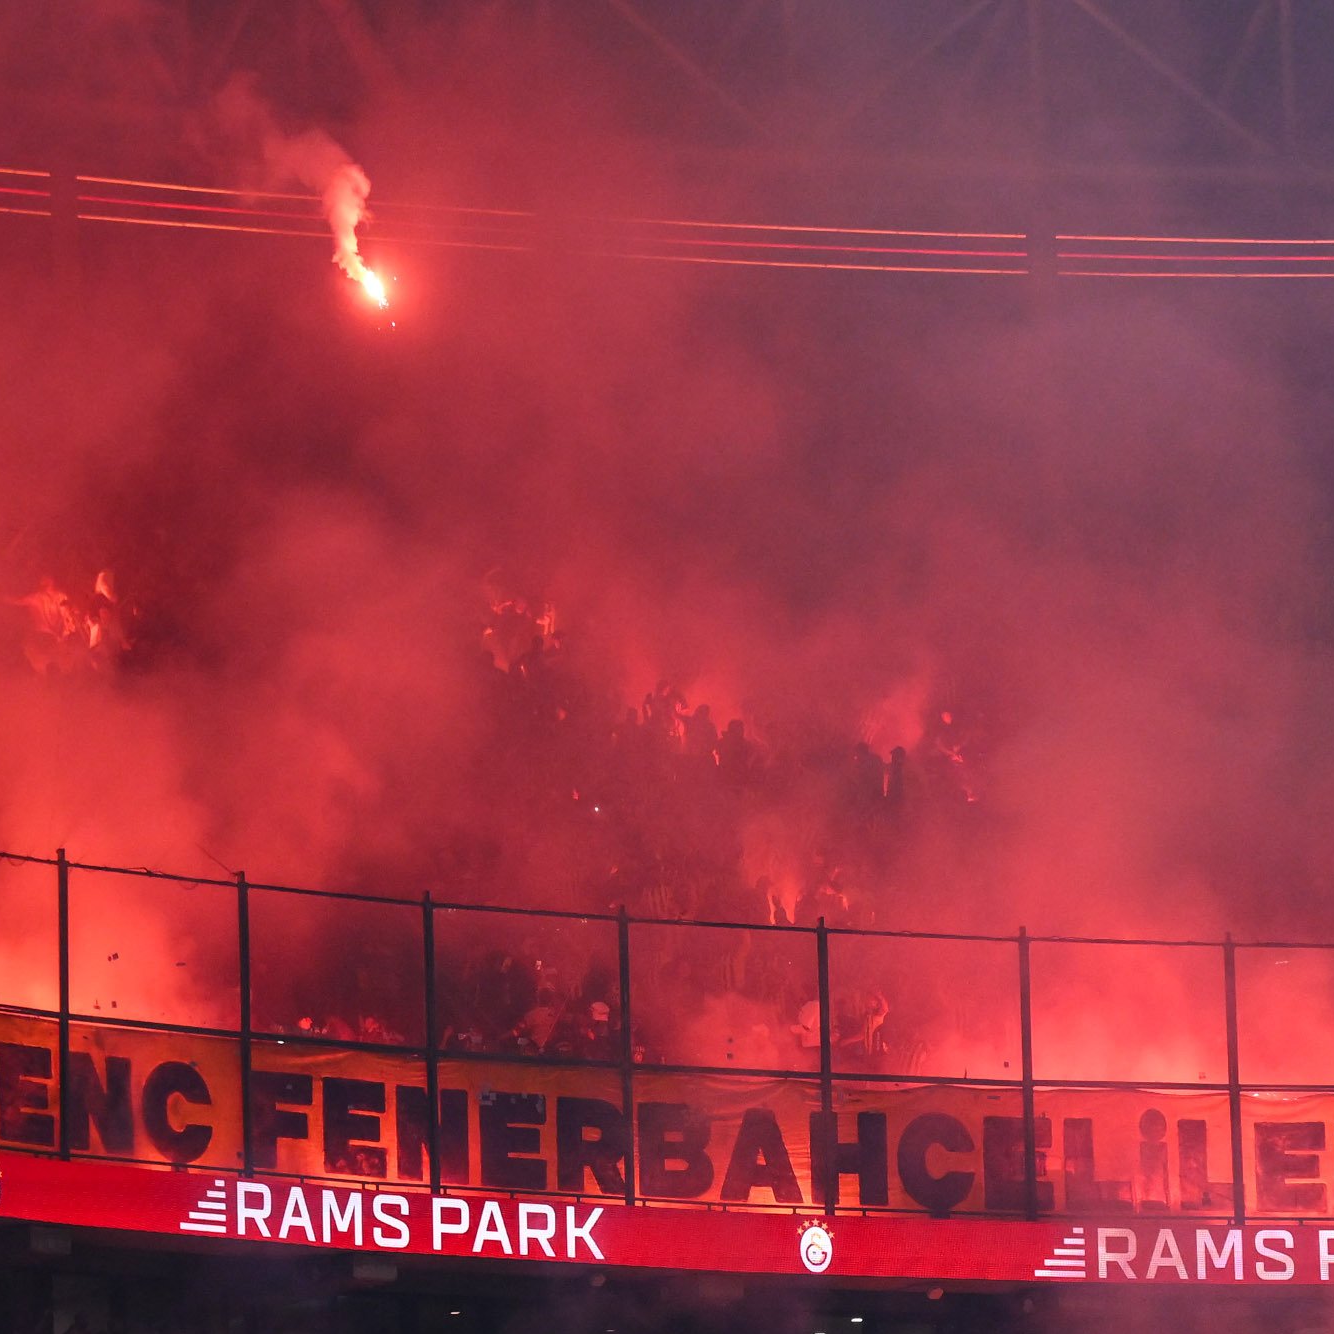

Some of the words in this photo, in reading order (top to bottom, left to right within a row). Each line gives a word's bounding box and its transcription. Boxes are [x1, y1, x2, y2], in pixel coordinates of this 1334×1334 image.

[237, 1182, 409, 1248] RAMS
[433, 1198, 604, 1259] PARK
[1097, 1228, 1294, 1280] RAMS
